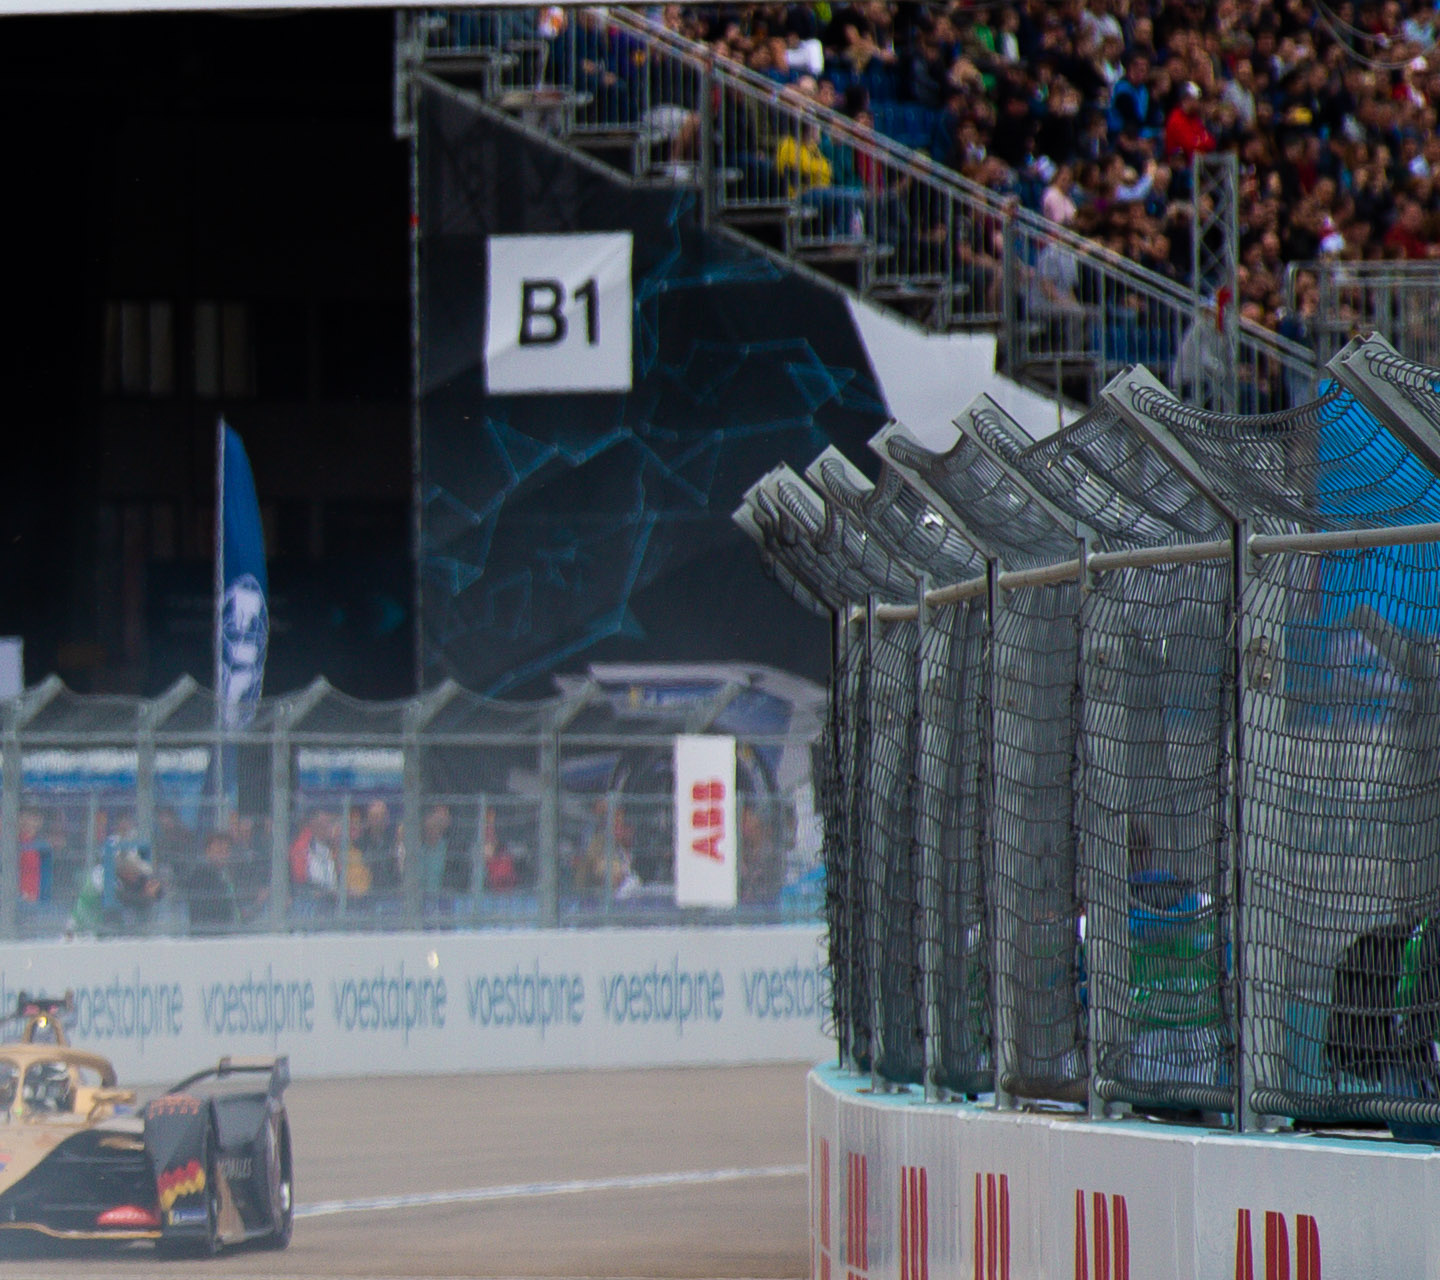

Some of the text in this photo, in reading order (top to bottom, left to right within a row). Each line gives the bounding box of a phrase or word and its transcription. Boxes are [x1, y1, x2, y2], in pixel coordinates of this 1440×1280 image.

[519, 276, 600, 348] B1
[691, 777, 726, 864] ABB
[202, 963, 315, 1050] voestalpine
[333, 959, 447, 1047] voestalpine
[467, 956, 585, 1040] voestalpine
[601, 951, 725, 1040] voestalpine
